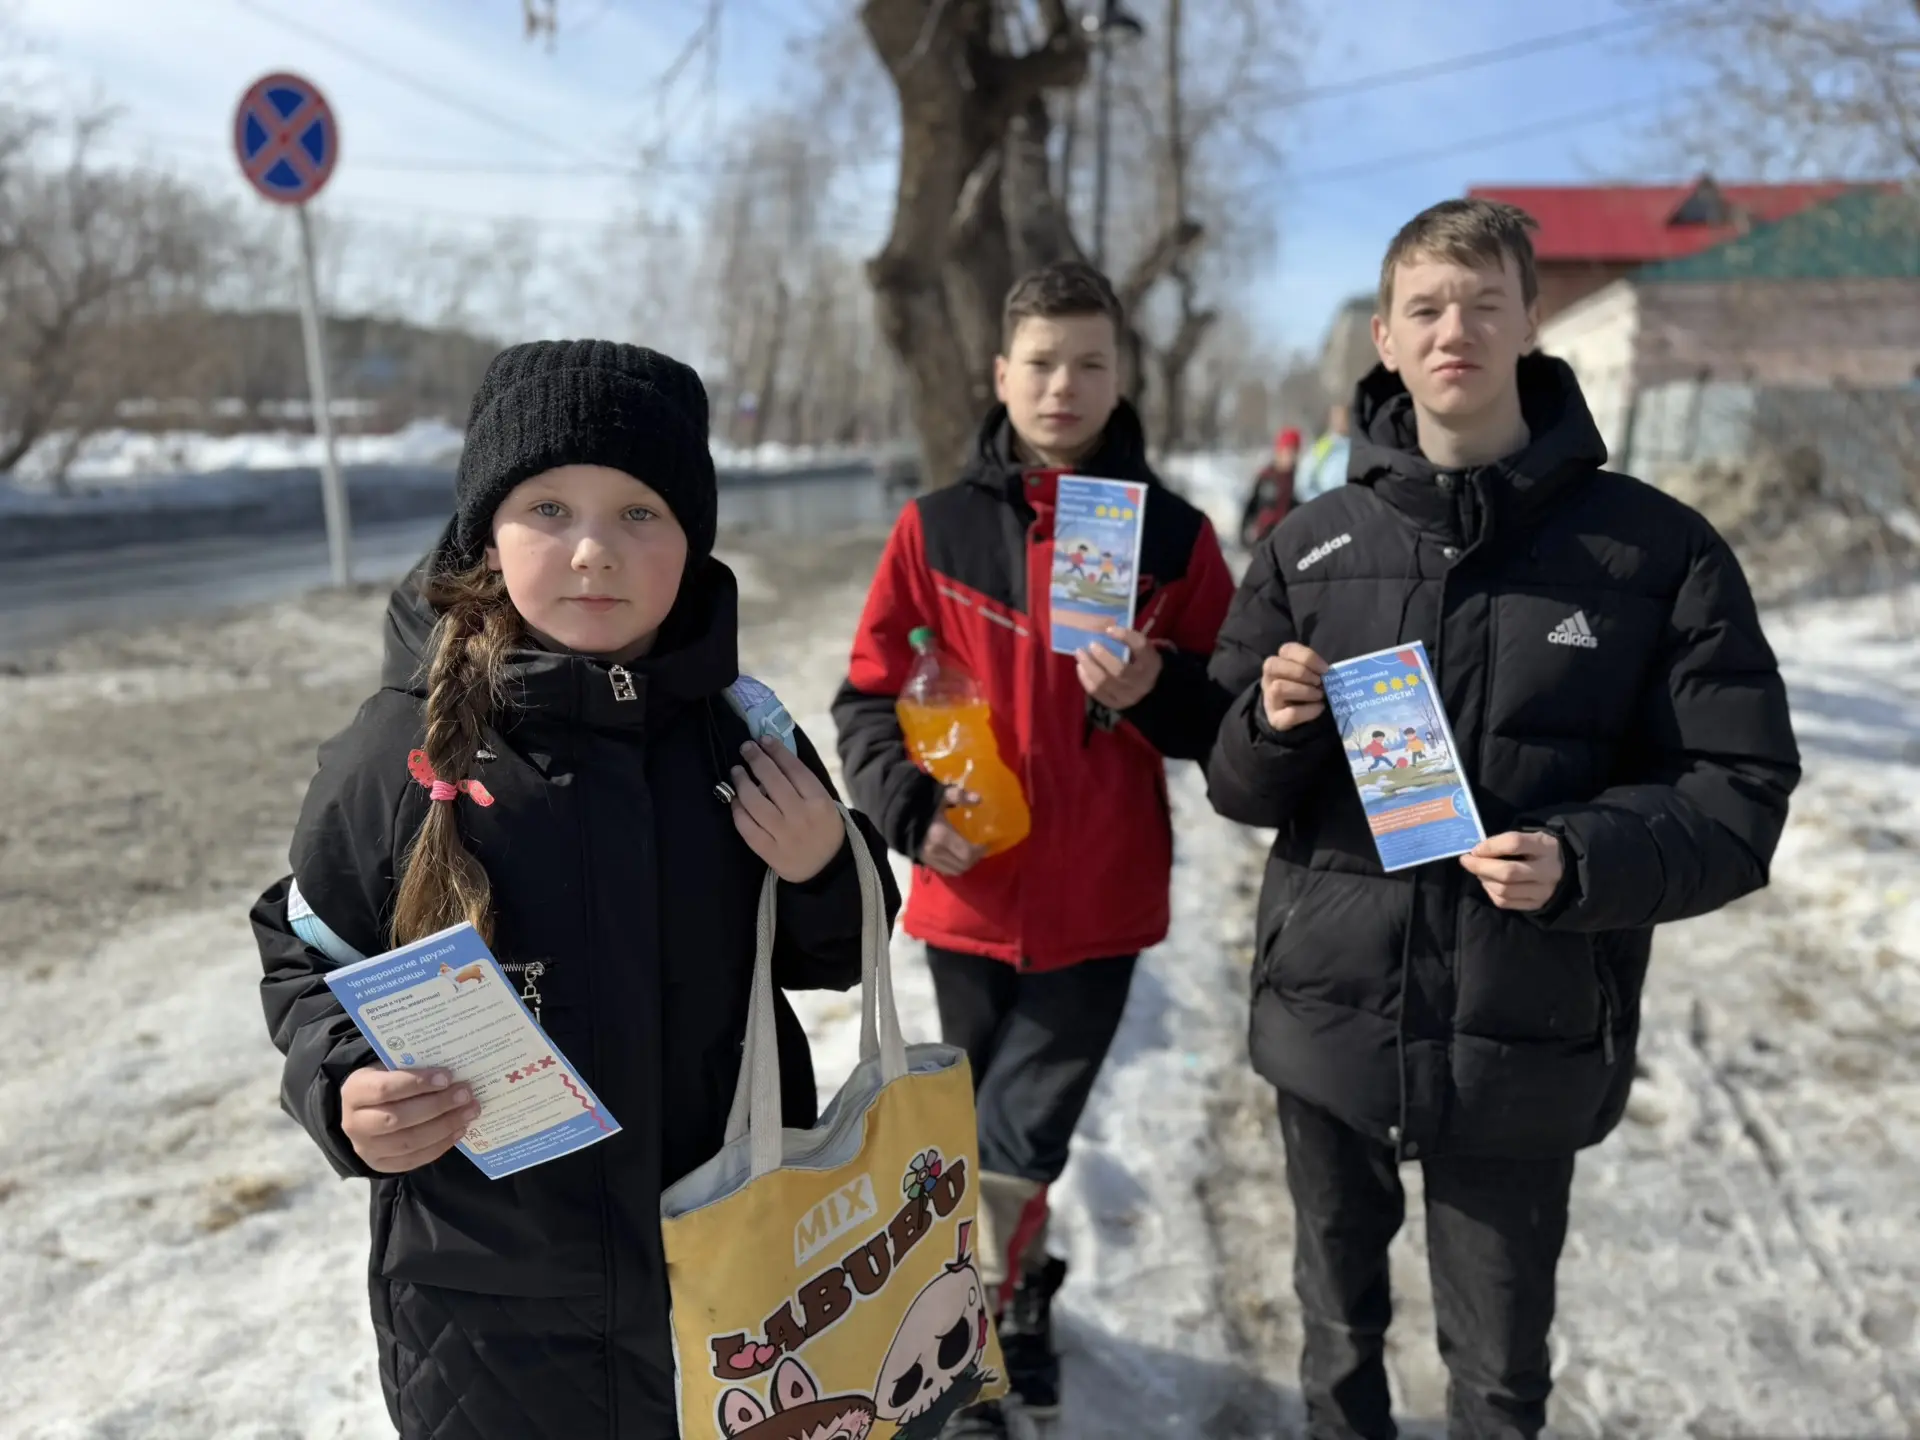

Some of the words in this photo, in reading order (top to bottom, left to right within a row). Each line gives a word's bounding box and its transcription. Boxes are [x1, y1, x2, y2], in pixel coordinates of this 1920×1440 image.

[1297, 533, 1352, 571] adidas
[1547, 632, 1598, 648] adidas
[346, 960, 417, 989] Четвероногие
[419, 944, 456, 965] друзья
[355, 991, 364, 1000] и
[364, 969, 427, 997] незнакомцы
[797, 1184, 870, 1253] MIX
[711, 1159, 966, 1379] LABUBU
